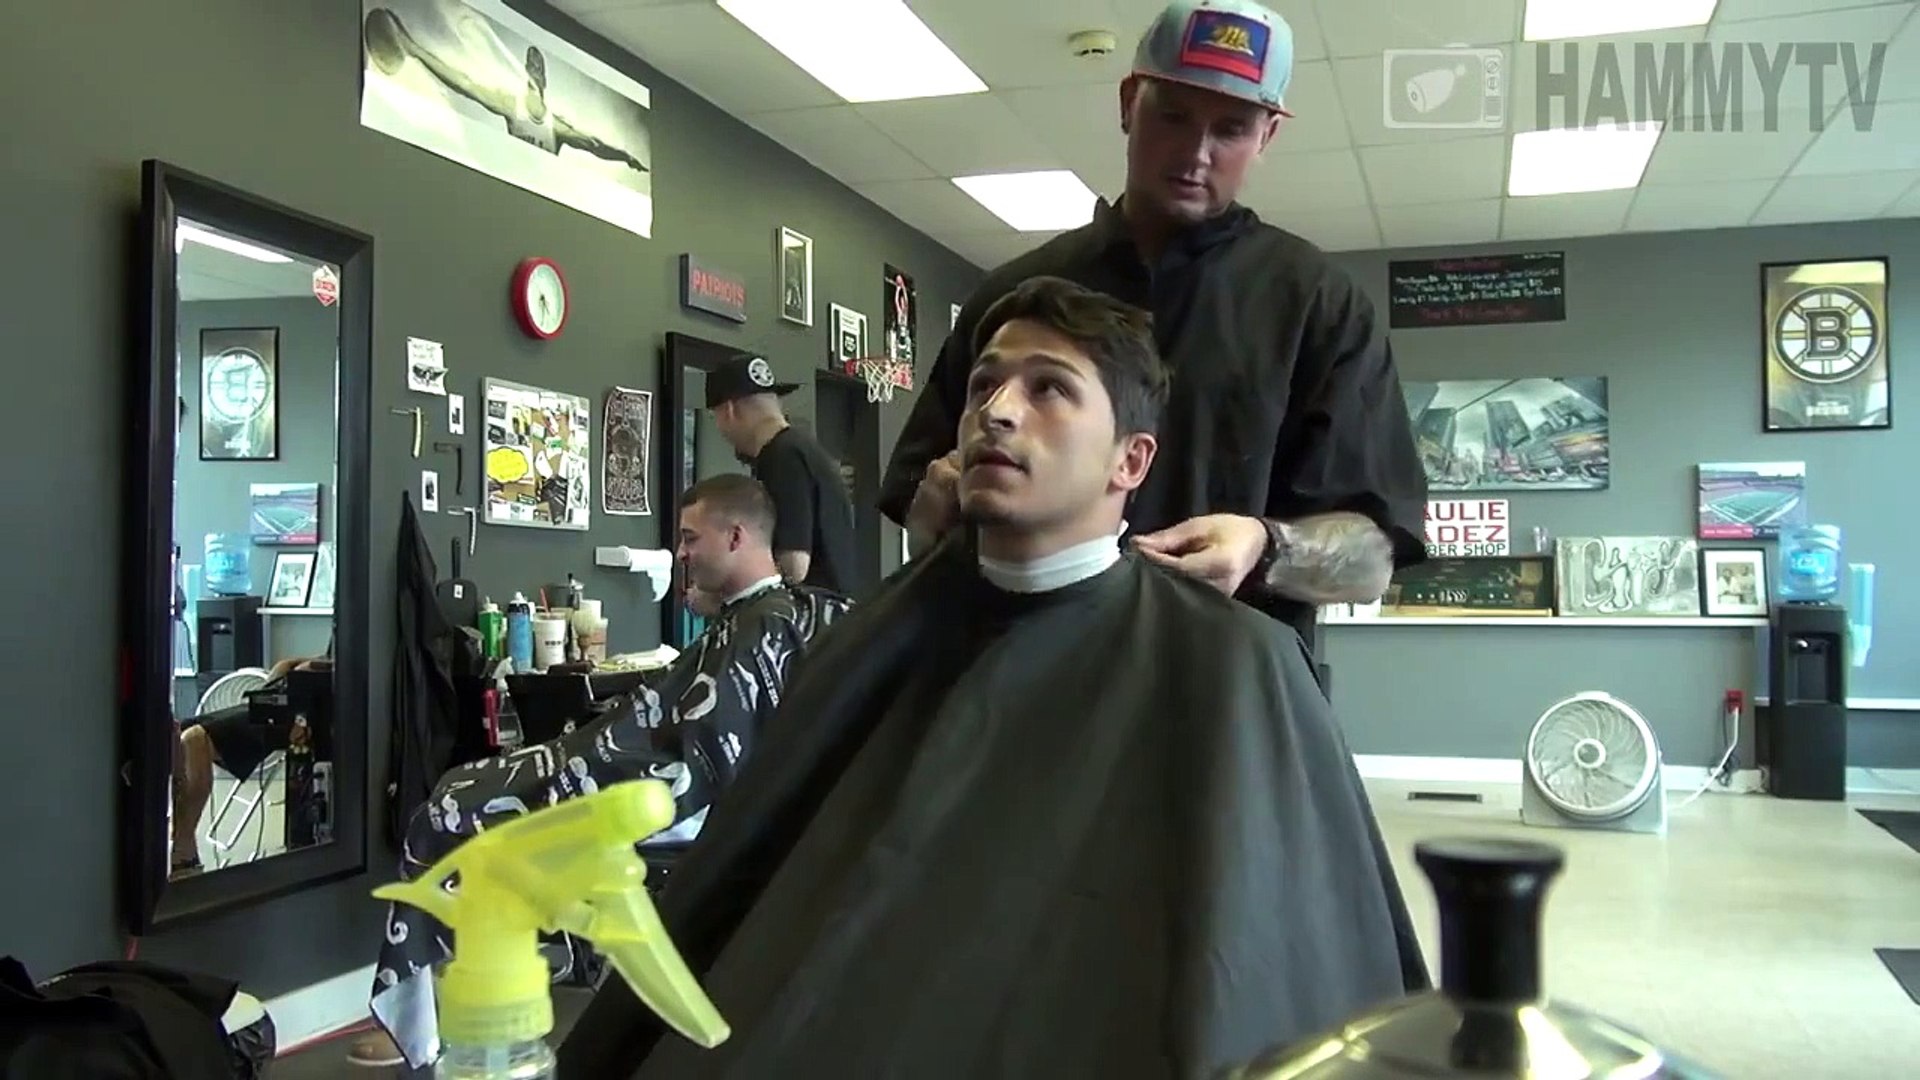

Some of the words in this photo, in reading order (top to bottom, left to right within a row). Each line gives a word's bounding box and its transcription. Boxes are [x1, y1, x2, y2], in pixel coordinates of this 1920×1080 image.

[693, 270, 745, 307] PATRIOTS
[1803, 307, 1852, 361] B
[1424, 544, 1457, 557] BER
[1463, 543, 1506, 557] SHOP
